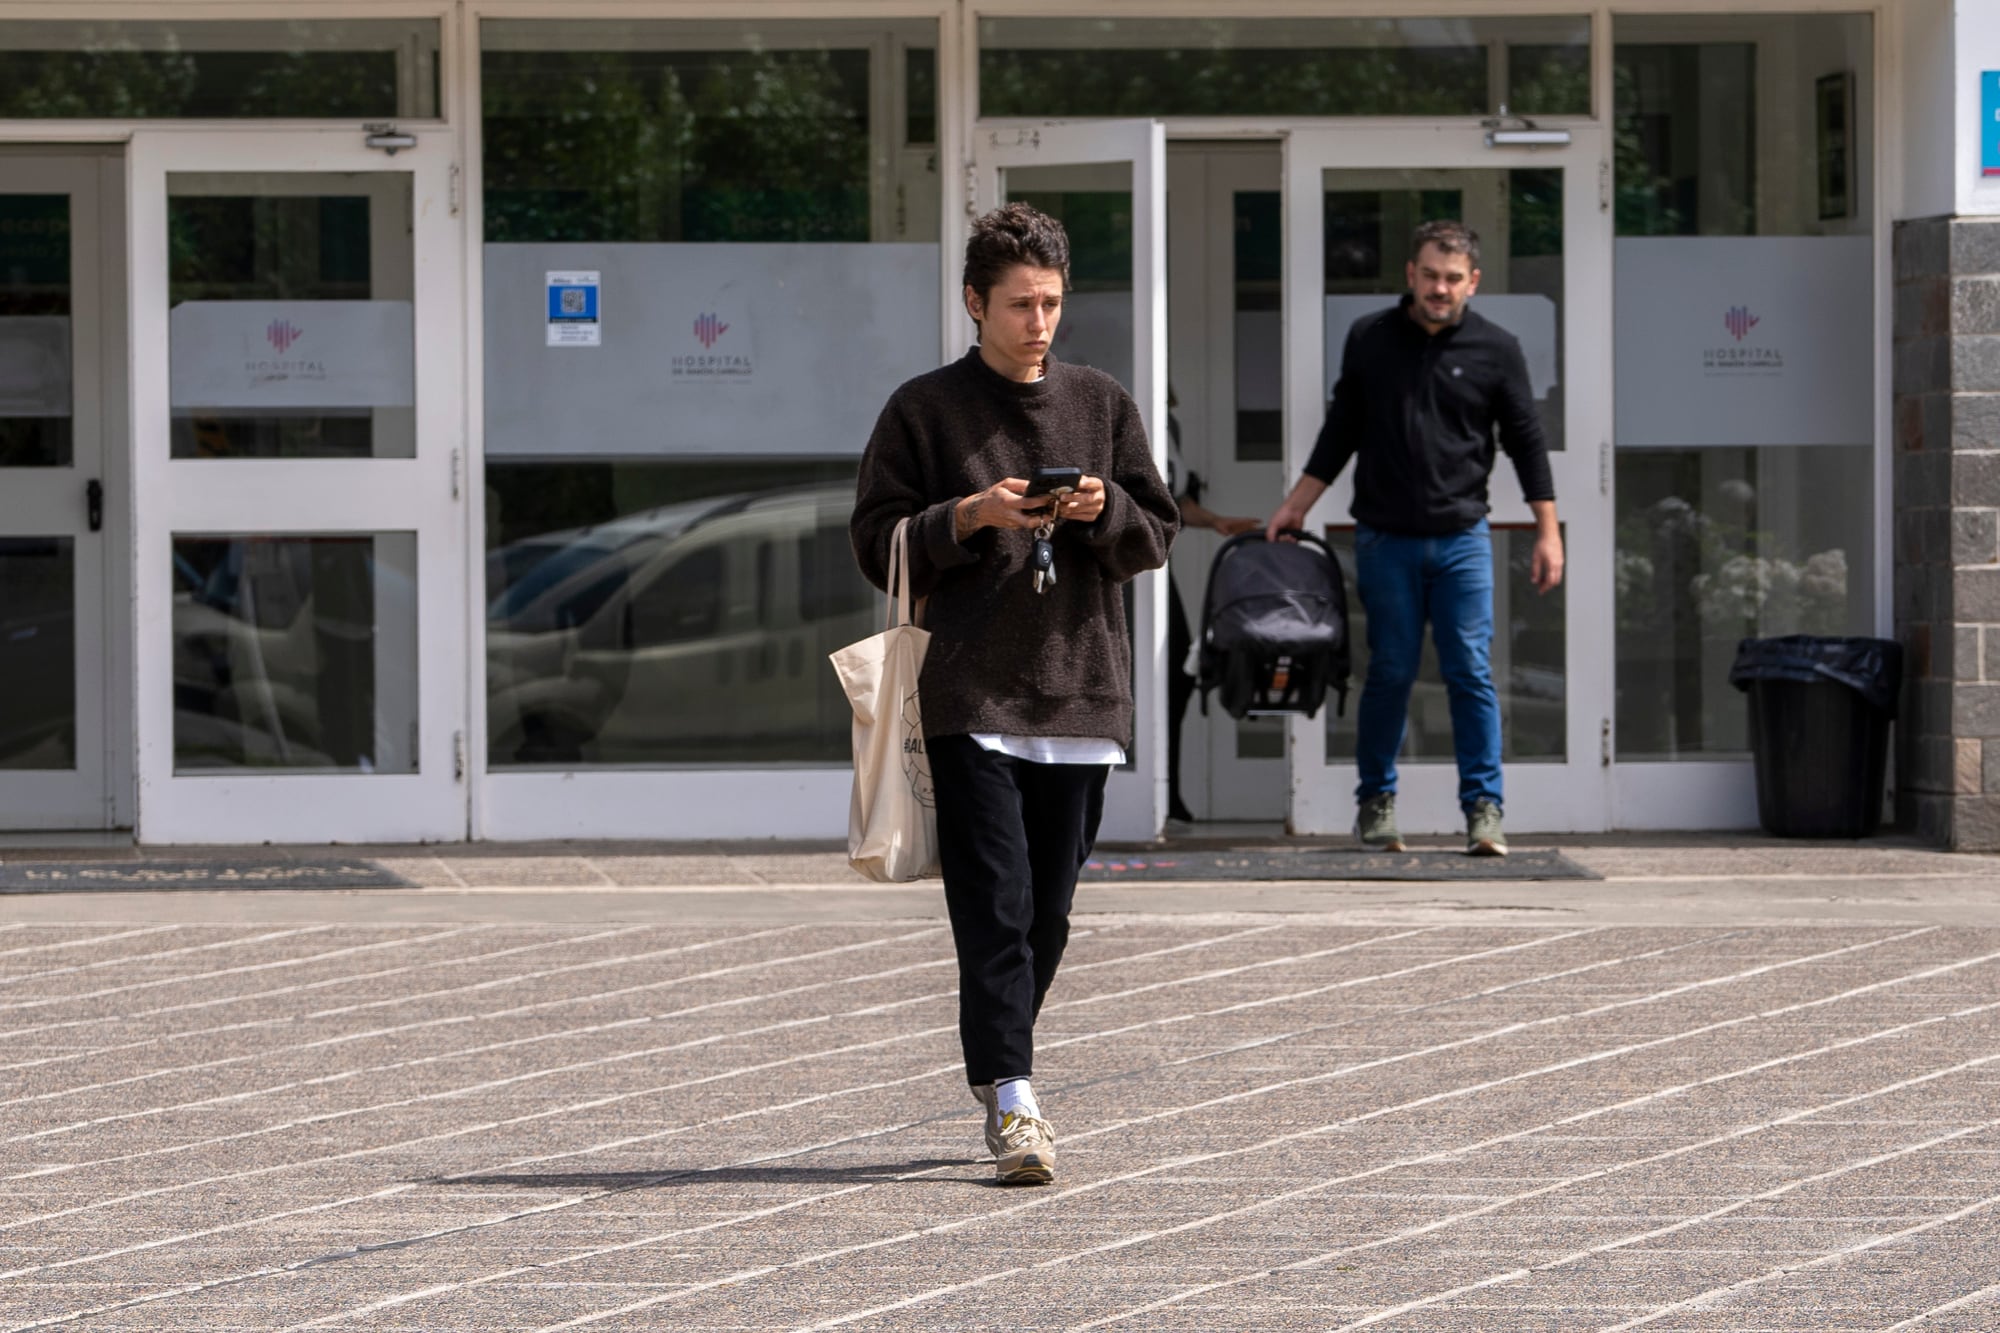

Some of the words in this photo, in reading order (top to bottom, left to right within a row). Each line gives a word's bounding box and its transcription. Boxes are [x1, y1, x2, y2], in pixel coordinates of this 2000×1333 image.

[1703, 347, 1784, 359] HOSPITAL
[244, 361, 327, 372] HOSPITAL
[671, 355, 752, 367] HOSPITAL
